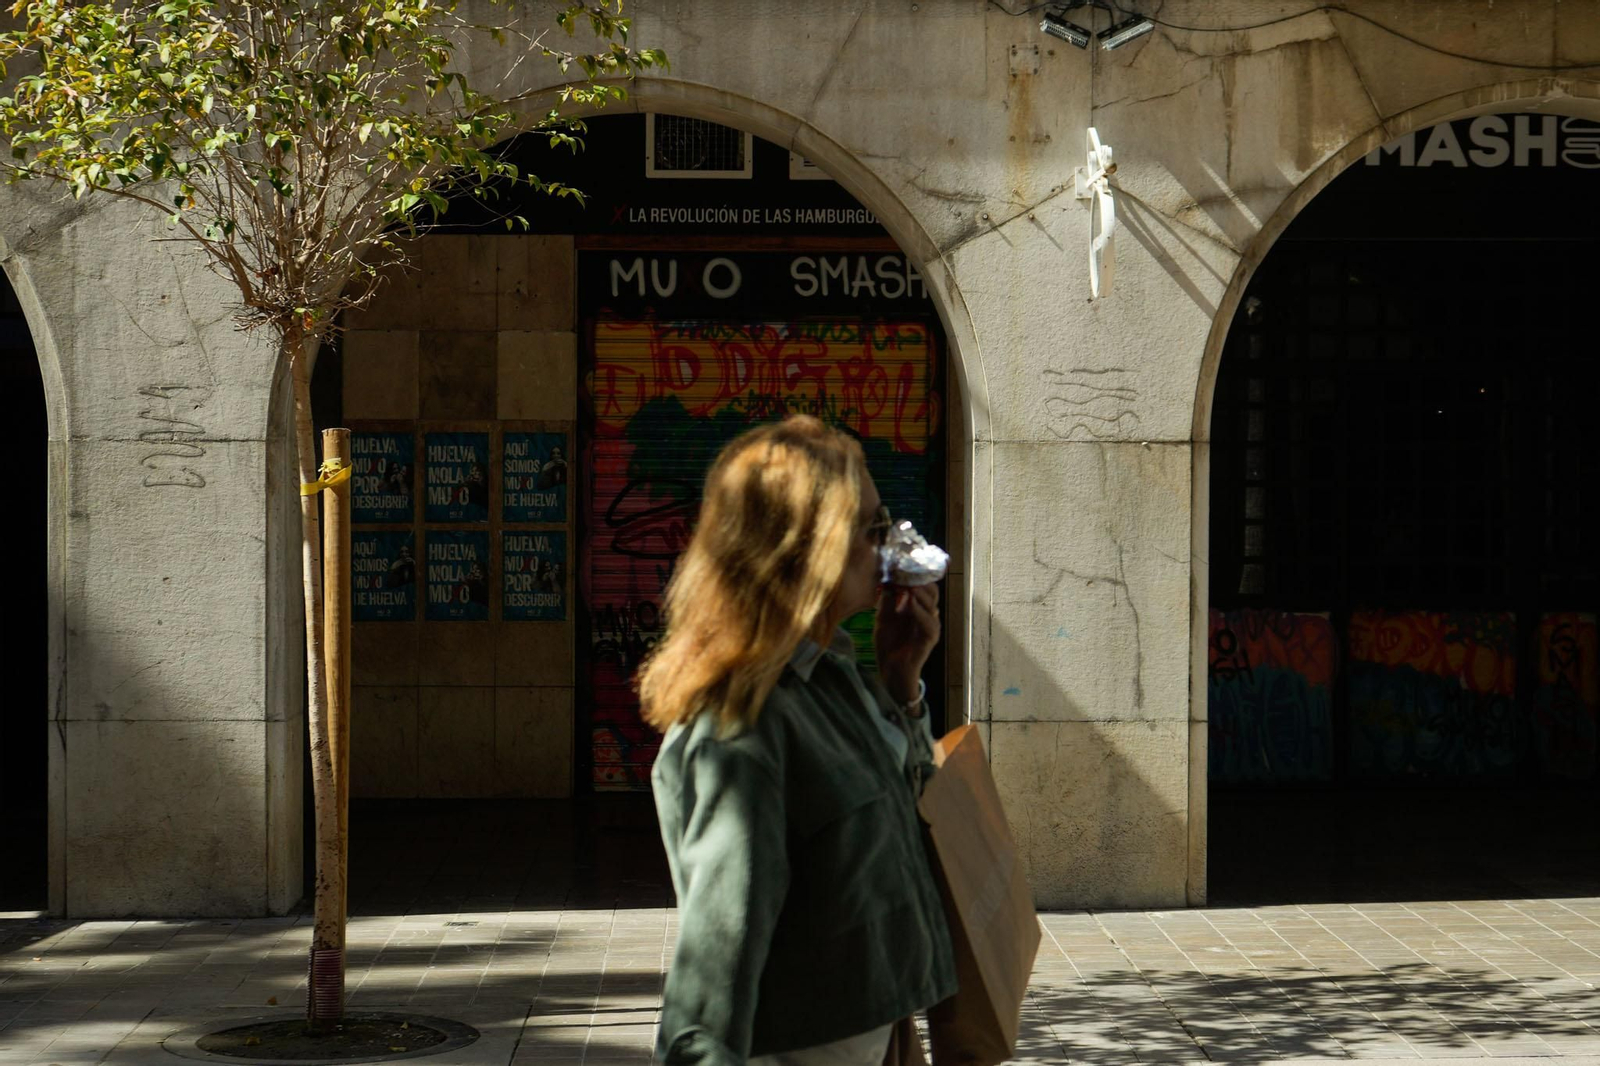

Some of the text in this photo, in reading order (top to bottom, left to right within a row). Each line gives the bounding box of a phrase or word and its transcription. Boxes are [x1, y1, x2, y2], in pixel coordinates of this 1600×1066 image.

[1365, 115, 1557, 168] MASH
[629, 207, 647, 223] LA
[650, 204, 738, 224] REVOLUCIÓN
[742, 208, 760, 224] DE
[765, 208, 791, 224] LAS
[795, 208, 880, 224] HAMBURGU
[790, 255, 928, 299] SMASH
[428, 445, 477, 463] HUELVA
[505, 439, 530, 458] AQUÍ
[428, 467, 464, 484] MOLA
[505, 459, 541, 474] SOMOS
[352, 475, 380, 494] POR
[352, 495, 409, 509] DESCUBRIR
[505, 493, 558, 507] DE HUELVA
[428, 543, 477, 561] HUELVA
[353, 558, 389, 573] SOMOS
[428, 564, 464, 582] MOLA
[505, 573, 532, 592] POR
[369, 591, 407, 606] HUELVA
[505, 592, 561, 607] DESCUBRIR
